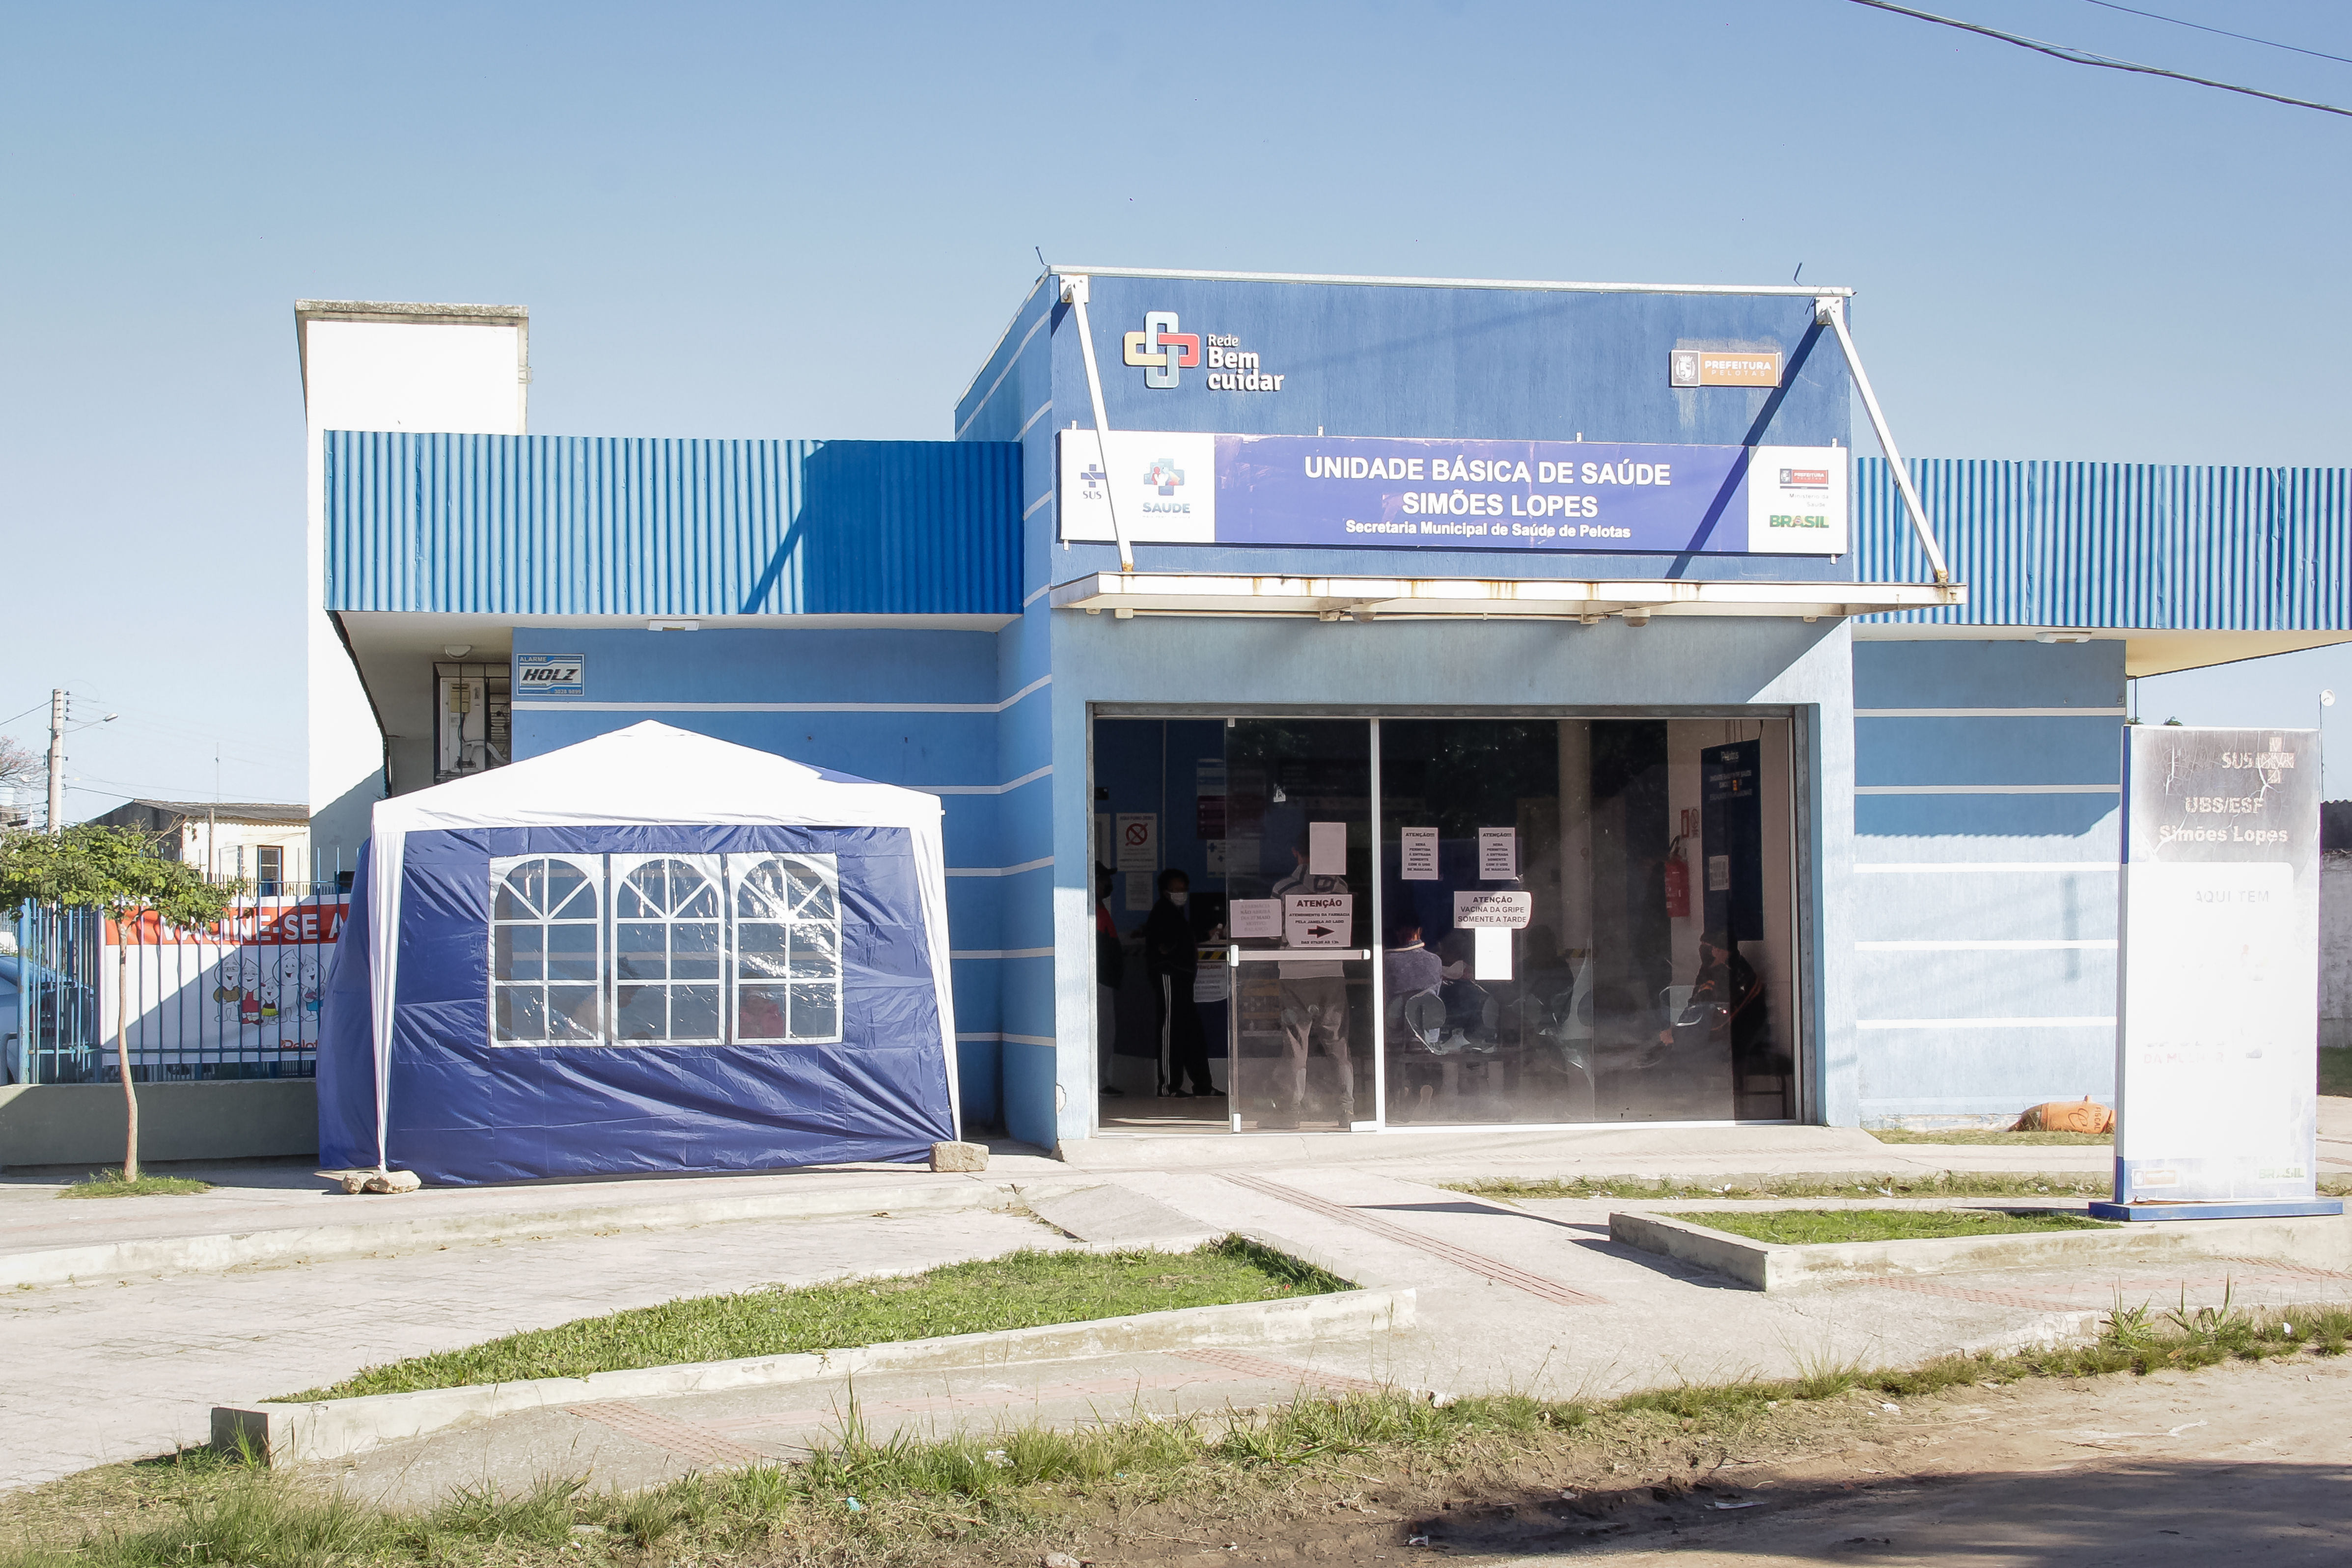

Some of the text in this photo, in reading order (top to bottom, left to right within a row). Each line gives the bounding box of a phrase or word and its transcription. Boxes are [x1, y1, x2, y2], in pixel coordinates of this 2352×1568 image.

[1208, 334, 1239, 347] Rede
[1208, 346, 1259, 368] Bem
[1704, 360, 1771, 370] PREFEITURA
[1208, 368, 1285, 391] cuidar
[1304, 454, 1671, 486] UNIDADE BÁSICA DE SAÚDE
[1082, 491, 1102, 499] SUS
[1402, 489, 1598, 518] SIMÕES LOPES
[1346, 519, 1631, 538] Secretaria Municipal de Saúde de Pelotas
[1770, 515, 1829, 528] BRASIL
[522, 668, 579, 681] HOLZ
[2221, 751, 2253, 769] SUS
[2185, 796, 2265, 814] UBS/ESF
[2159, 825, 2289, 846] Simões Lopes
[1296, 898, 1342, 908] ATENÇÃO
[1472, 896, 1513, 905] ATENÇÃO
[2195, 890, 2269, 903] AQUI TEM
